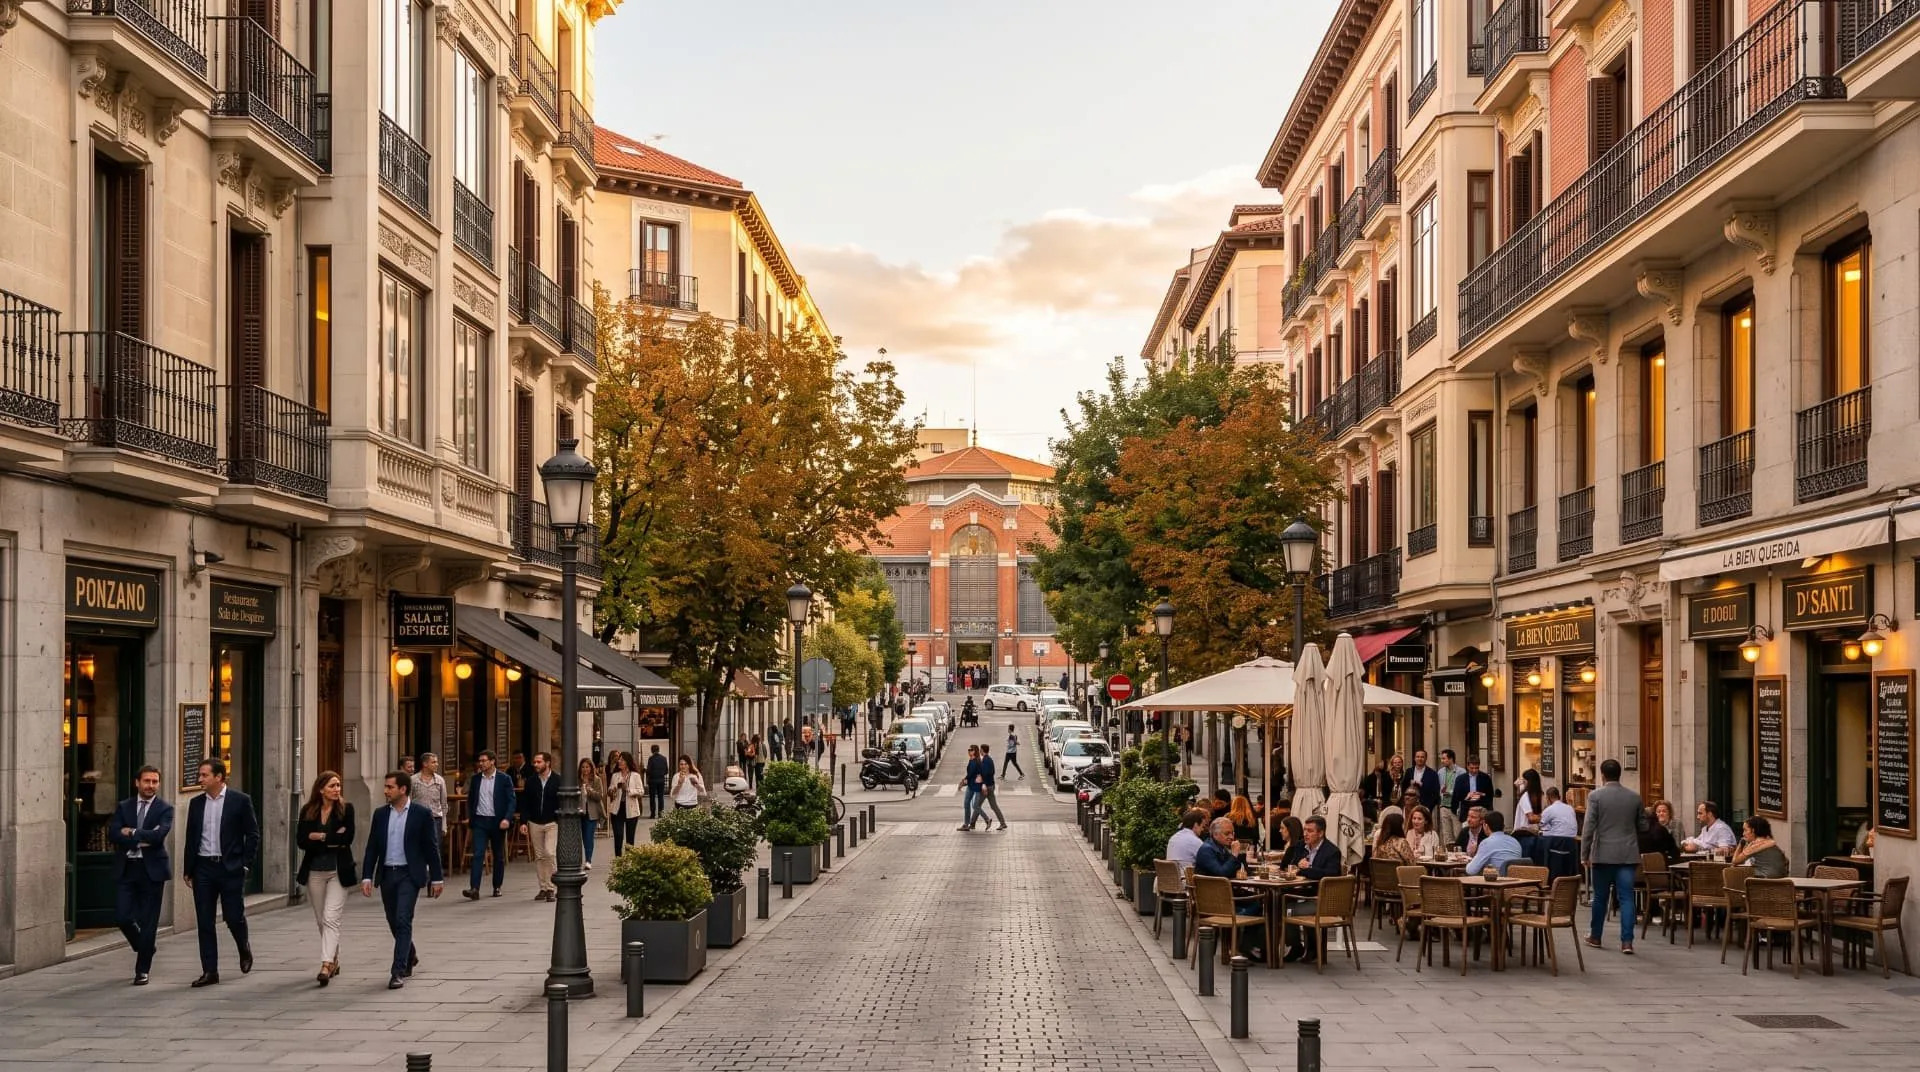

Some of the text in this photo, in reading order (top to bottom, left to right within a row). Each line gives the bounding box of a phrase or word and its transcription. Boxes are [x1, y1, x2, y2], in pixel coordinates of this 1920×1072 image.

[1722, 540, 1801, 568] LA BIEN QUERIDA
[75, 576, 146, 612] PONZANO
[223, 591, 259, 607] Restaurante
[217, 606, 231, 620] Sala
[231, 608, 240, 621] de
[404, 612, 431, 624] SALA
[399, 624, 450, 636] DESPIECE
[1526, 627, 1543, 646] BIEN
[1544, 622, 1580, 647] QUERIDA
